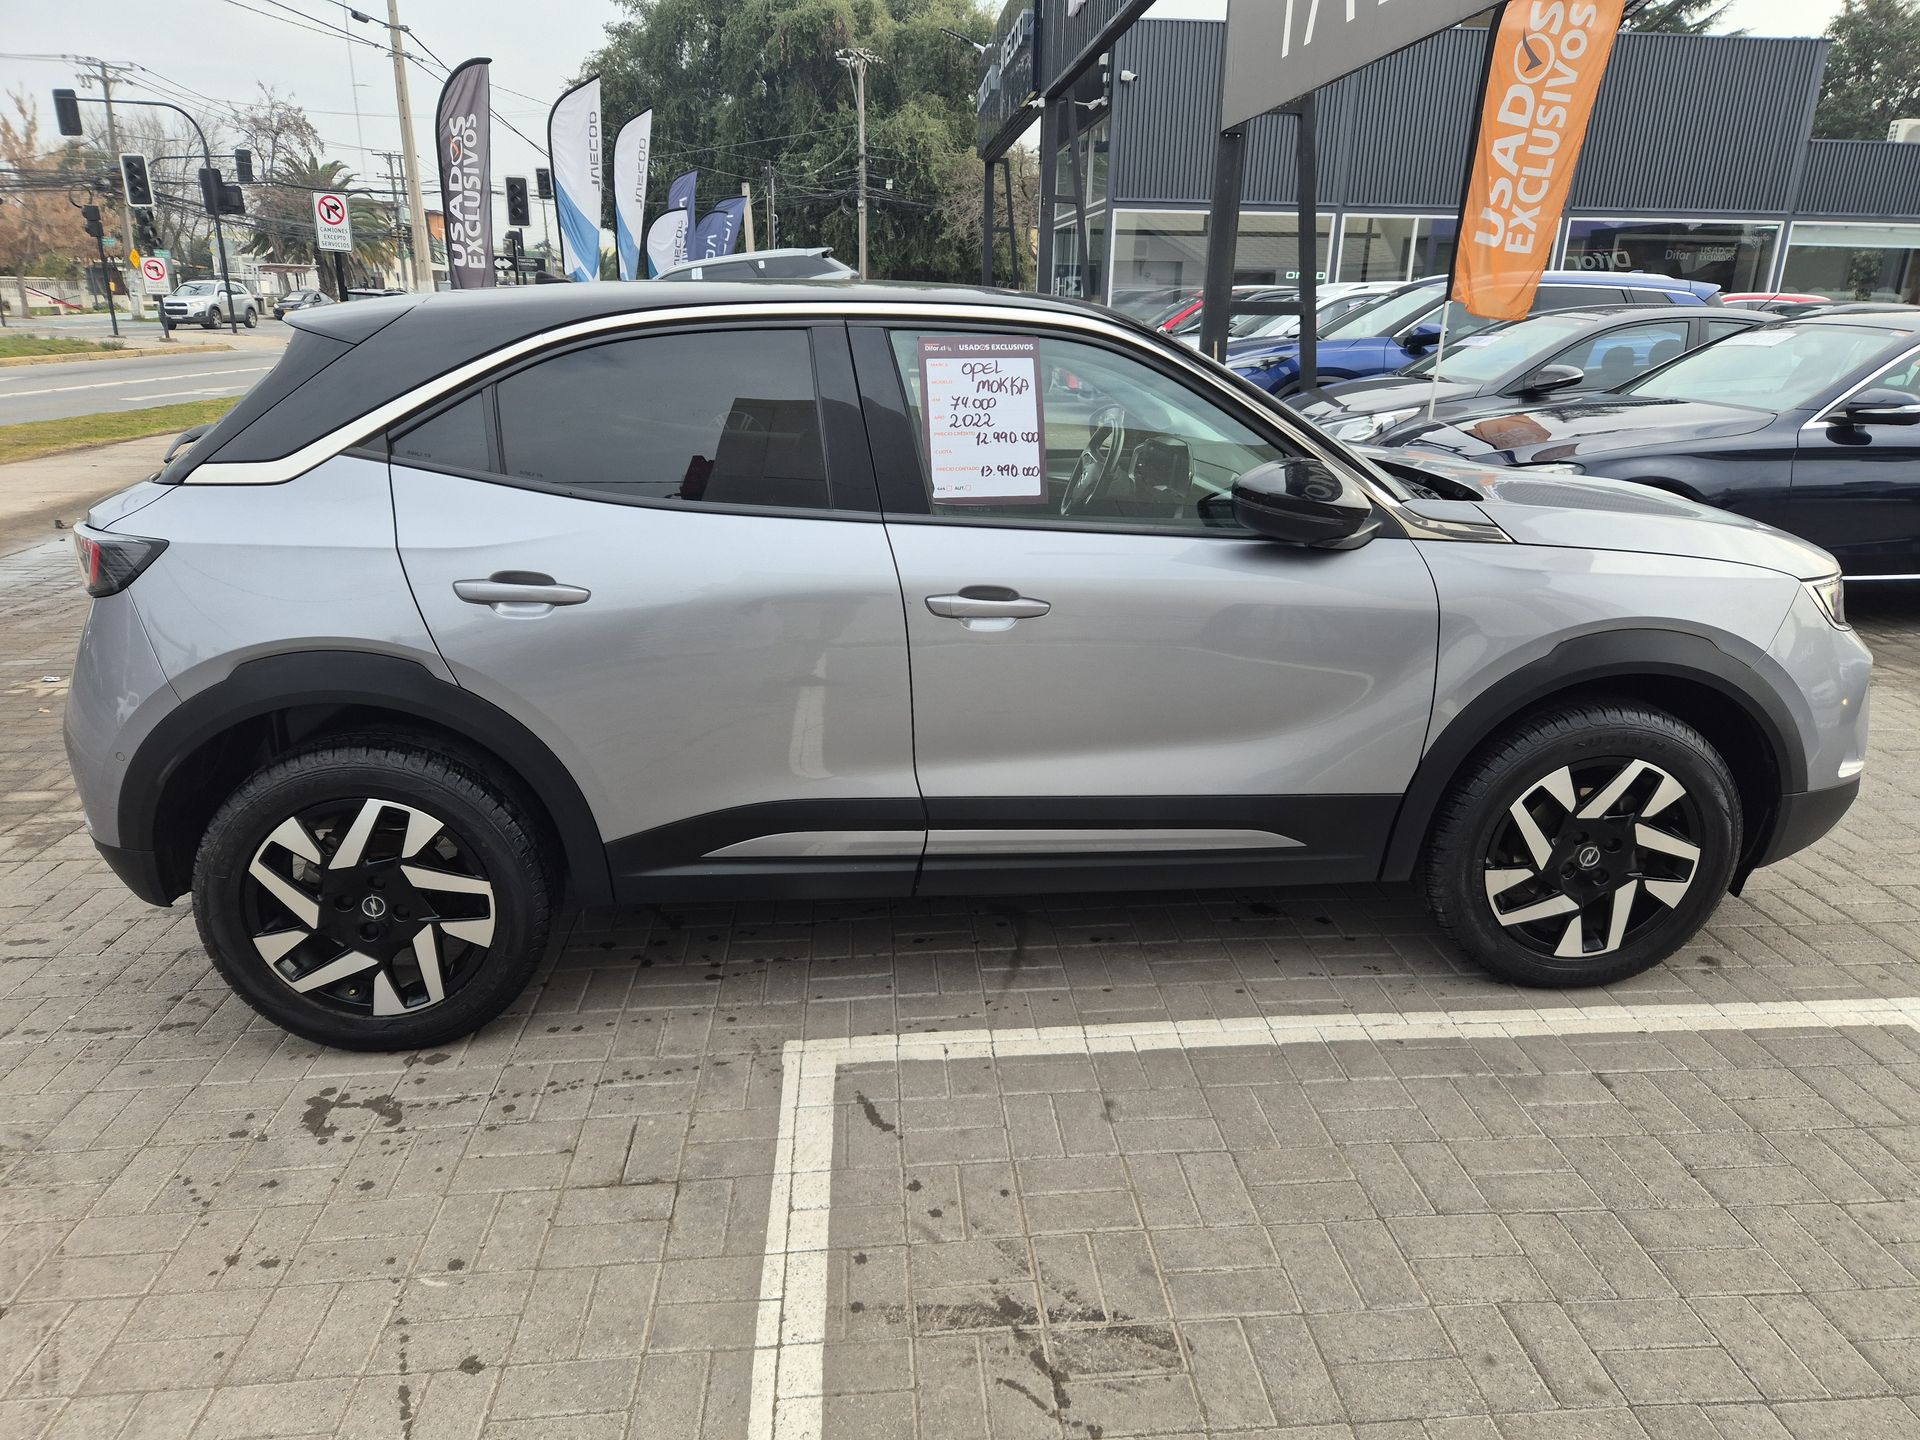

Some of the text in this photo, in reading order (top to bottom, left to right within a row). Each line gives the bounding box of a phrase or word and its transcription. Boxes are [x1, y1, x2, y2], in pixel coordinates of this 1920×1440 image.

[1473, 0, 1565, 248] USADOS
[1503, 2, 1597, 254] EXCLUSIVOS
[588, 111, 601, 192] JAECOO
[635, 138, 646, 210] JAECOO
[448, 116, 467, 267] USADOS
[462, 113, 486, 269] EXCLUSIVOS
[1664, 249, 1691, 261] Difor
[958, 343, 1034, 351] USADOS EXCLUSIVOS
[961, 360, 1003, 382] OPEL
[976, 376, 1029, 396] MOKKA
[949, 413, 995, 428] 2022
[950, 395, 997, 411] 74.000
